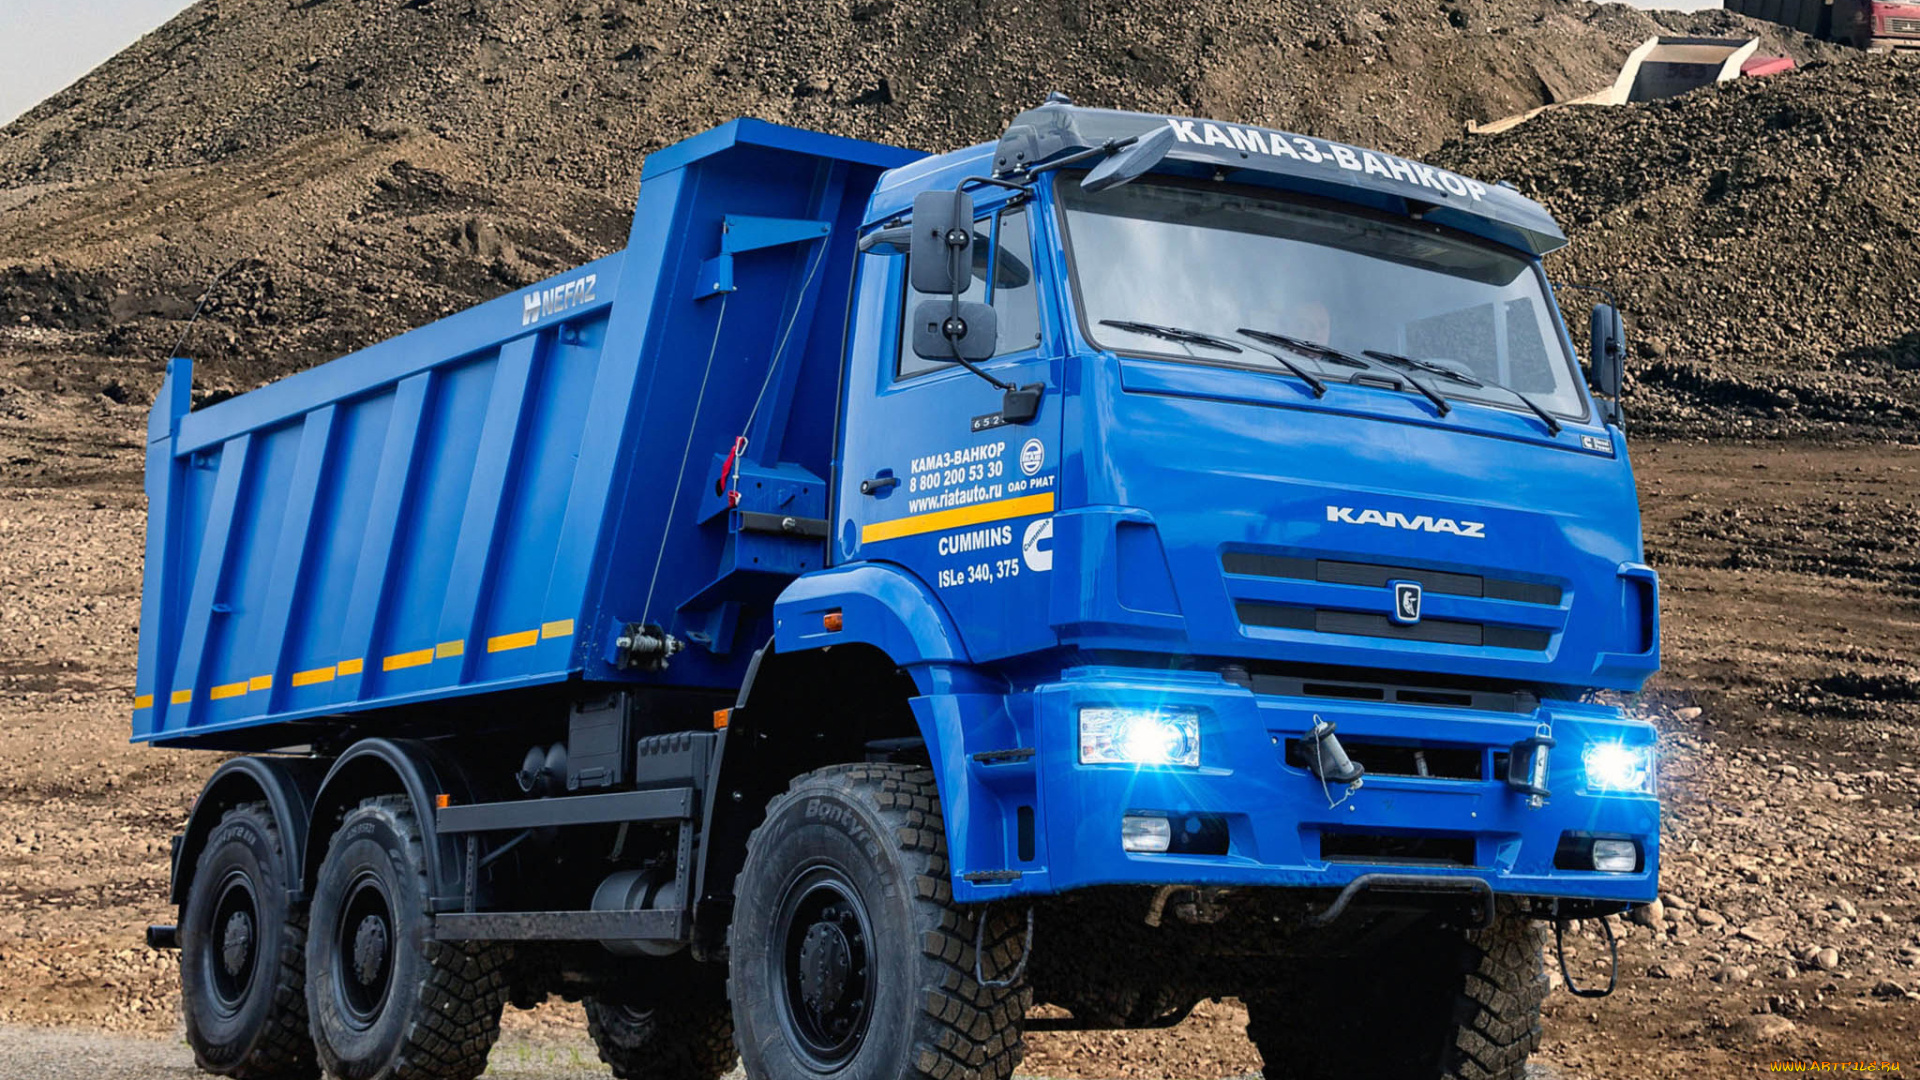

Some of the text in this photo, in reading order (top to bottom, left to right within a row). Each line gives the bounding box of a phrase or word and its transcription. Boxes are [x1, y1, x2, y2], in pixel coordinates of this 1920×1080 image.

[1167, 117, 1489, 202] КАМАЗ-ВАНКОР
[542, 274, 597, 317] NEFAZ
[973, 415, 1006, 430] 652
[910, 441, 1006, 475] КАМАЗ-ВАНКОР
[909, 460, 1003, 493] 8 800 200 53 30
[1007, 475, 1055, 493] ОАО РИАТ
[908, 483, 1003, 514] www.riatauto.ru
[1327, 505, 1485, 538] KAMAZ
[938, 525, 1012, 556] CUMMINS
[938, 569, 965, 588] ISLe
[996, 558, 1019, 579] 375
